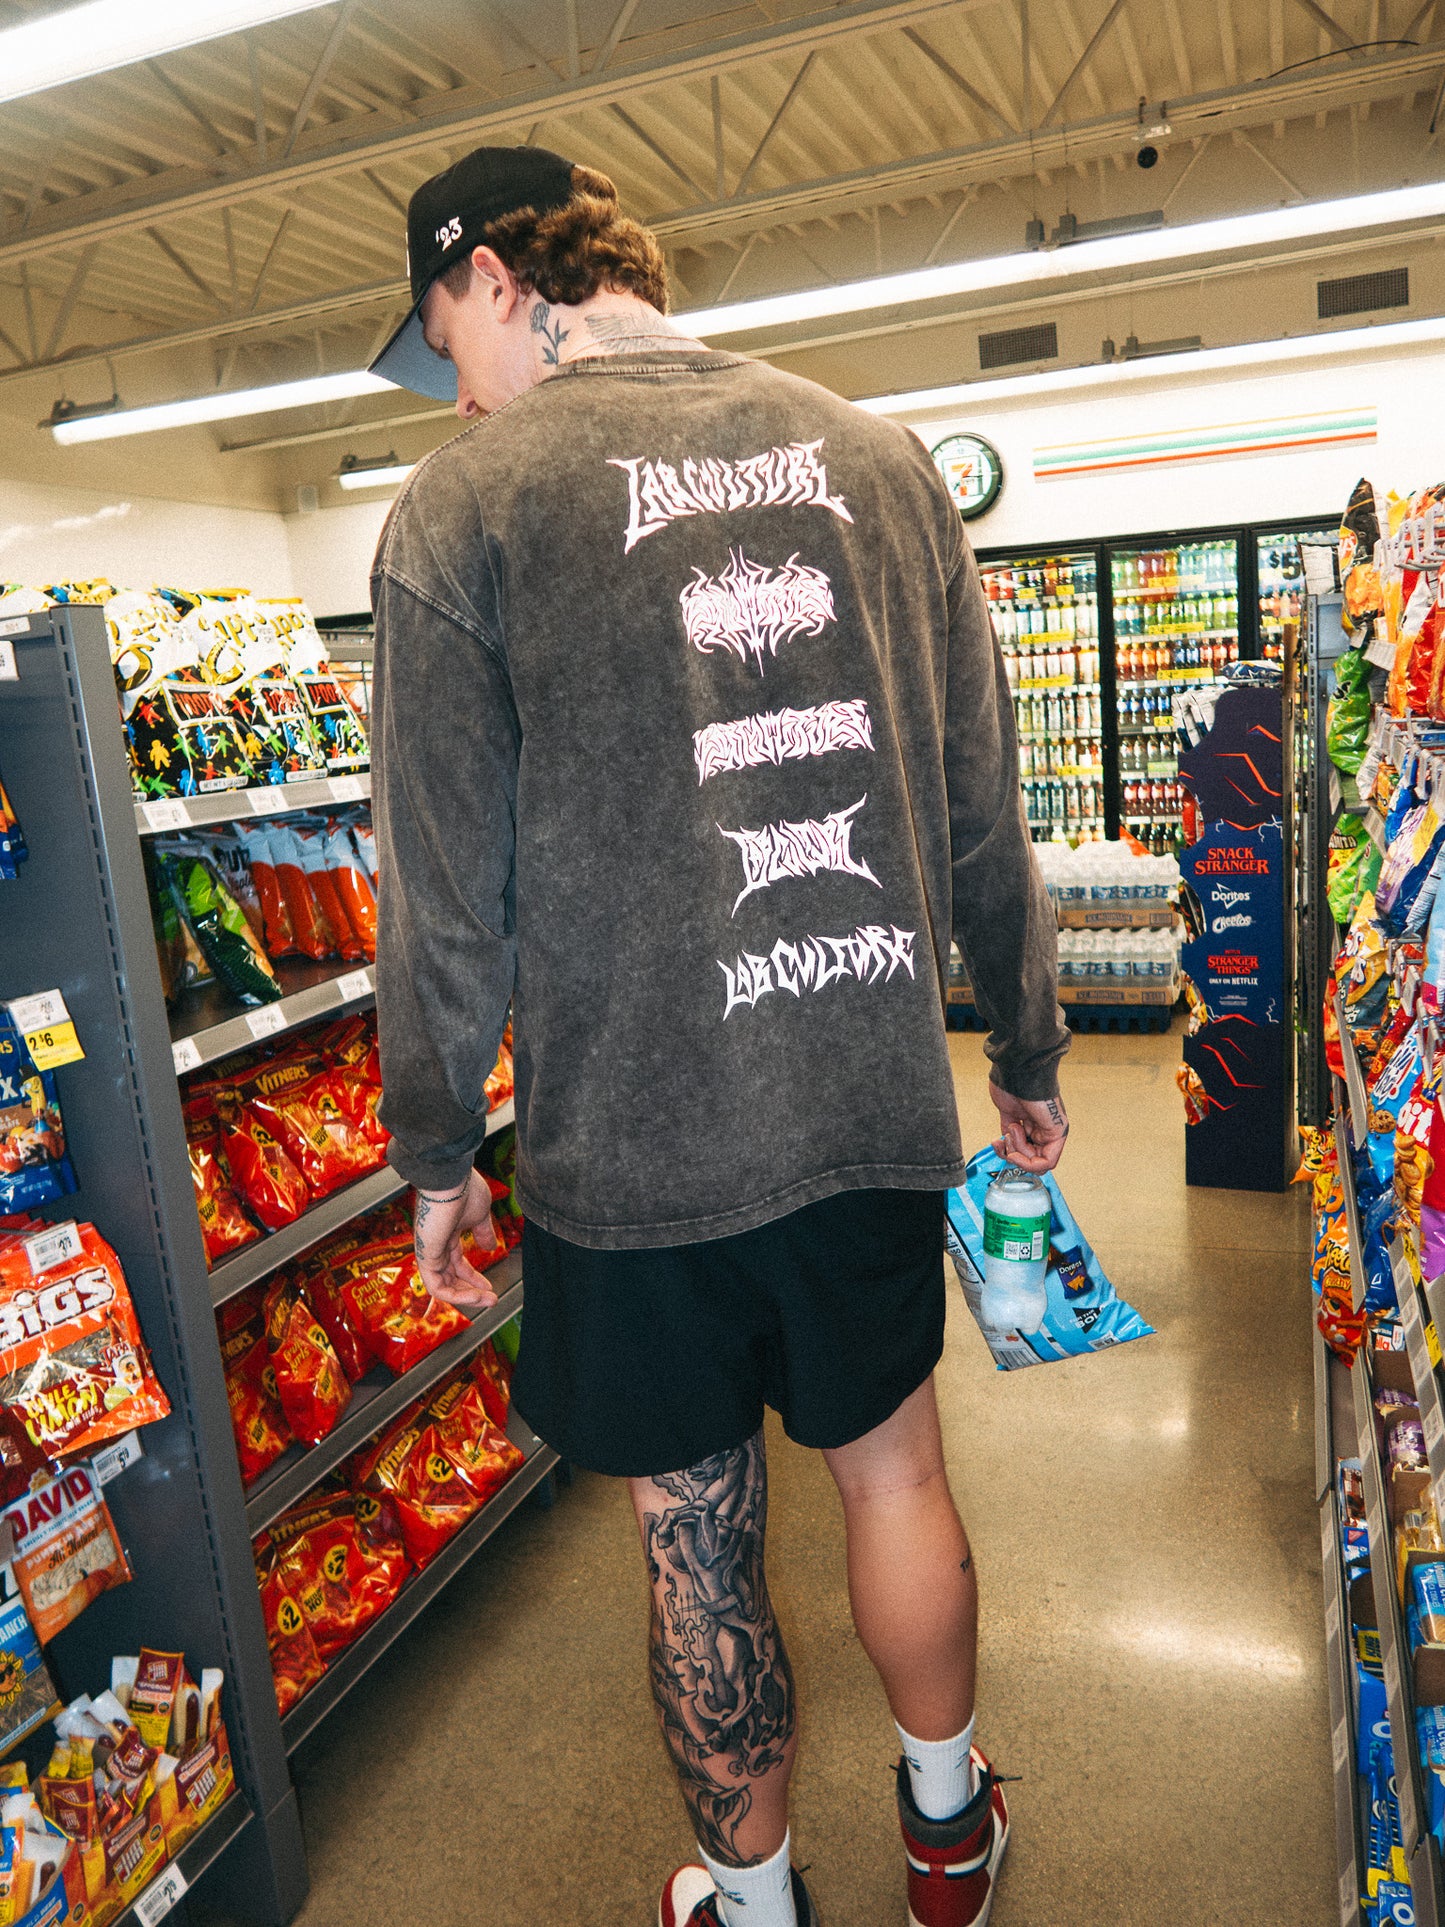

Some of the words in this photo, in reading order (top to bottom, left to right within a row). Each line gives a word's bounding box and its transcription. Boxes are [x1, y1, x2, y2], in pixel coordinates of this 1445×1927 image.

[1208, 847, 1255, 860] SNACK
[1194, 859, 1270, 875] STRANGER
[1211, 890, 1251, 902] Doritos
[1212, 913, 1253, 934] Cheetos
[1207, 955, 1259, 969] STRANGER
[1216, 966, 1252, 975] THINGS
[1232, 977, 1259, 986] NETFLIX
[1059, 1260, 1082, 1274] Doritos
[4, 1469, 93, 1542] DAVID
